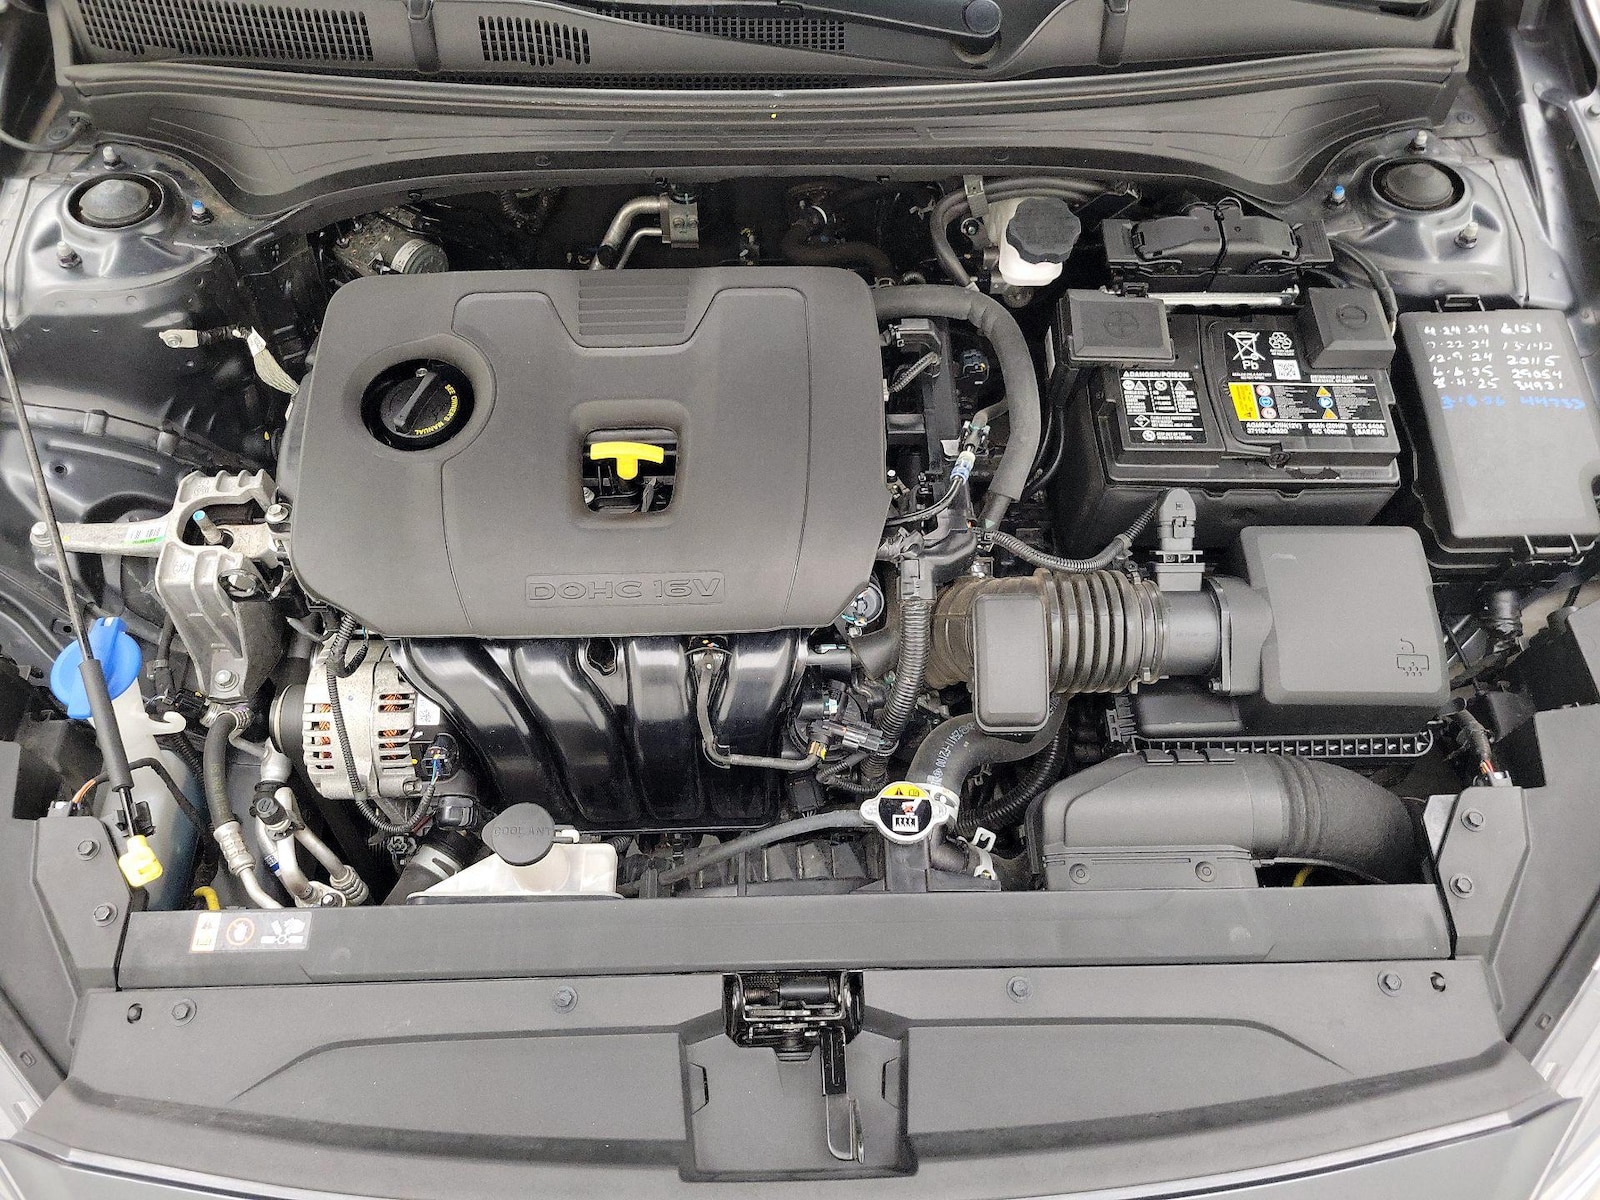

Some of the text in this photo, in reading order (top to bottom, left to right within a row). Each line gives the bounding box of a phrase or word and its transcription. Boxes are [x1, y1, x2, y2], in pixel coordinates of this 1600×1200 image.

[1242, 360, 1259, 370] Pb
[444, 383, 456, 395] SEE
[414, 421, 445, 435] MANUAL
[529, 578, 720, 600] DOHC 16V
